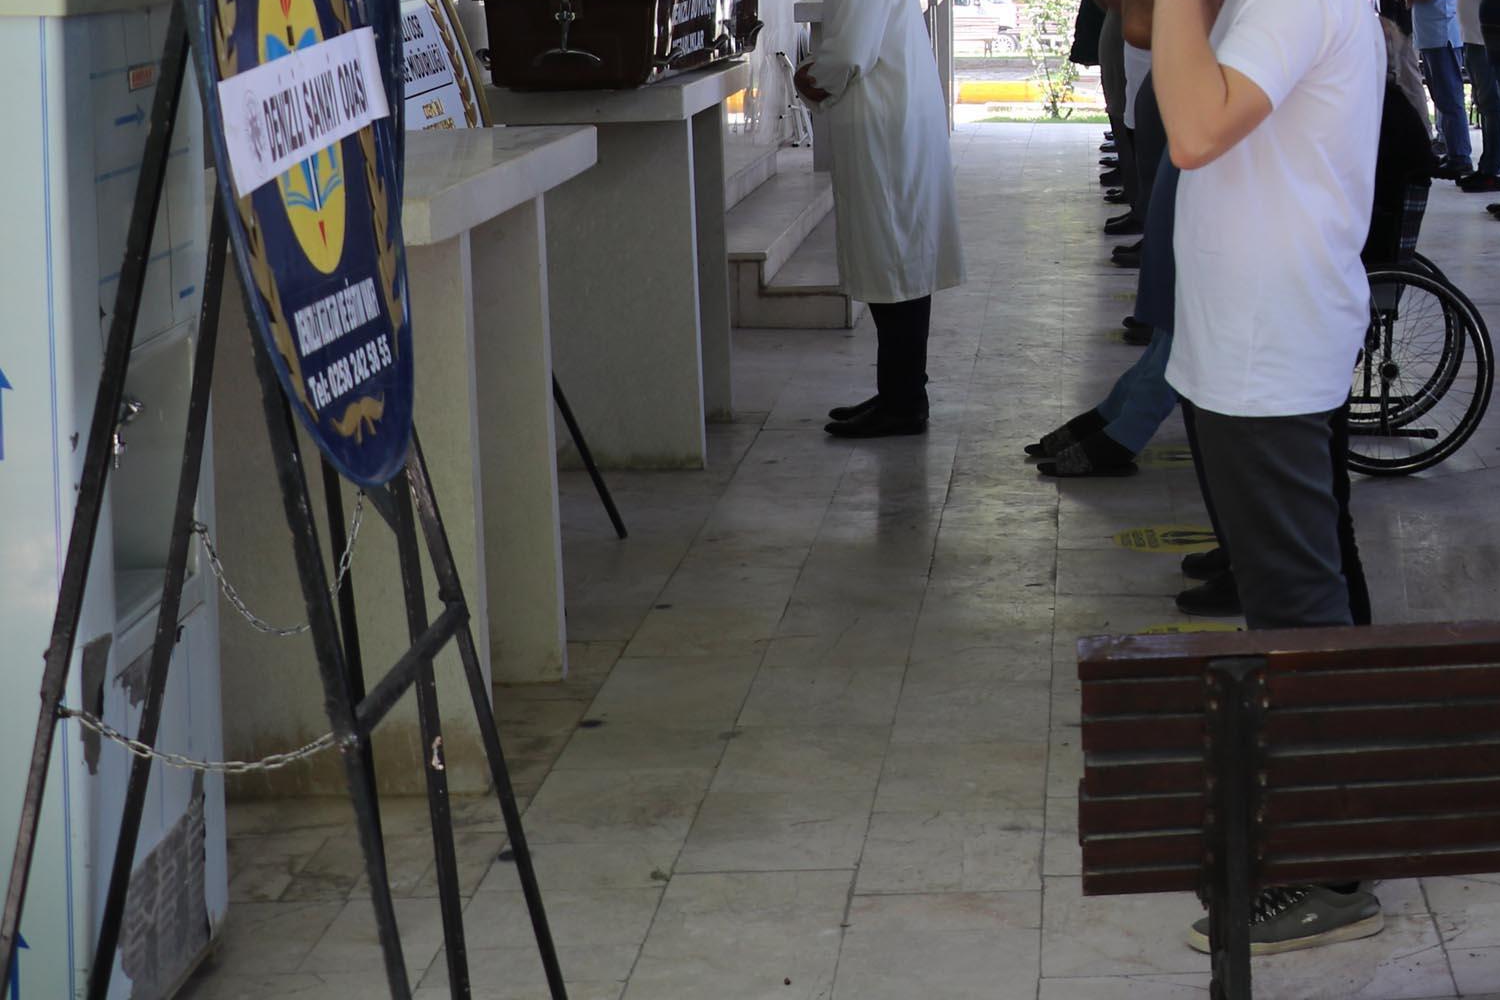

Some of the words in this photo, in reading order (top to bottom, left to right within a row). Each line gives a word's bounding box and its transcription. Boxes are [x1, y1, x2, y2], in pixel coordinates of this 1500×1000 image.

[263, 68, 306, 162] DENİZLİ
[302, 53, 341, 140] SANAYİ
[337, 58, 369, 121] ODASI
[308, 371, 332, 410] Tel:
[328, 356, 353, 398] 0258
[349, 347, 371, 385] 242
[366, 340, 381, 374] 58
[377, 333, 392, 367] 55
